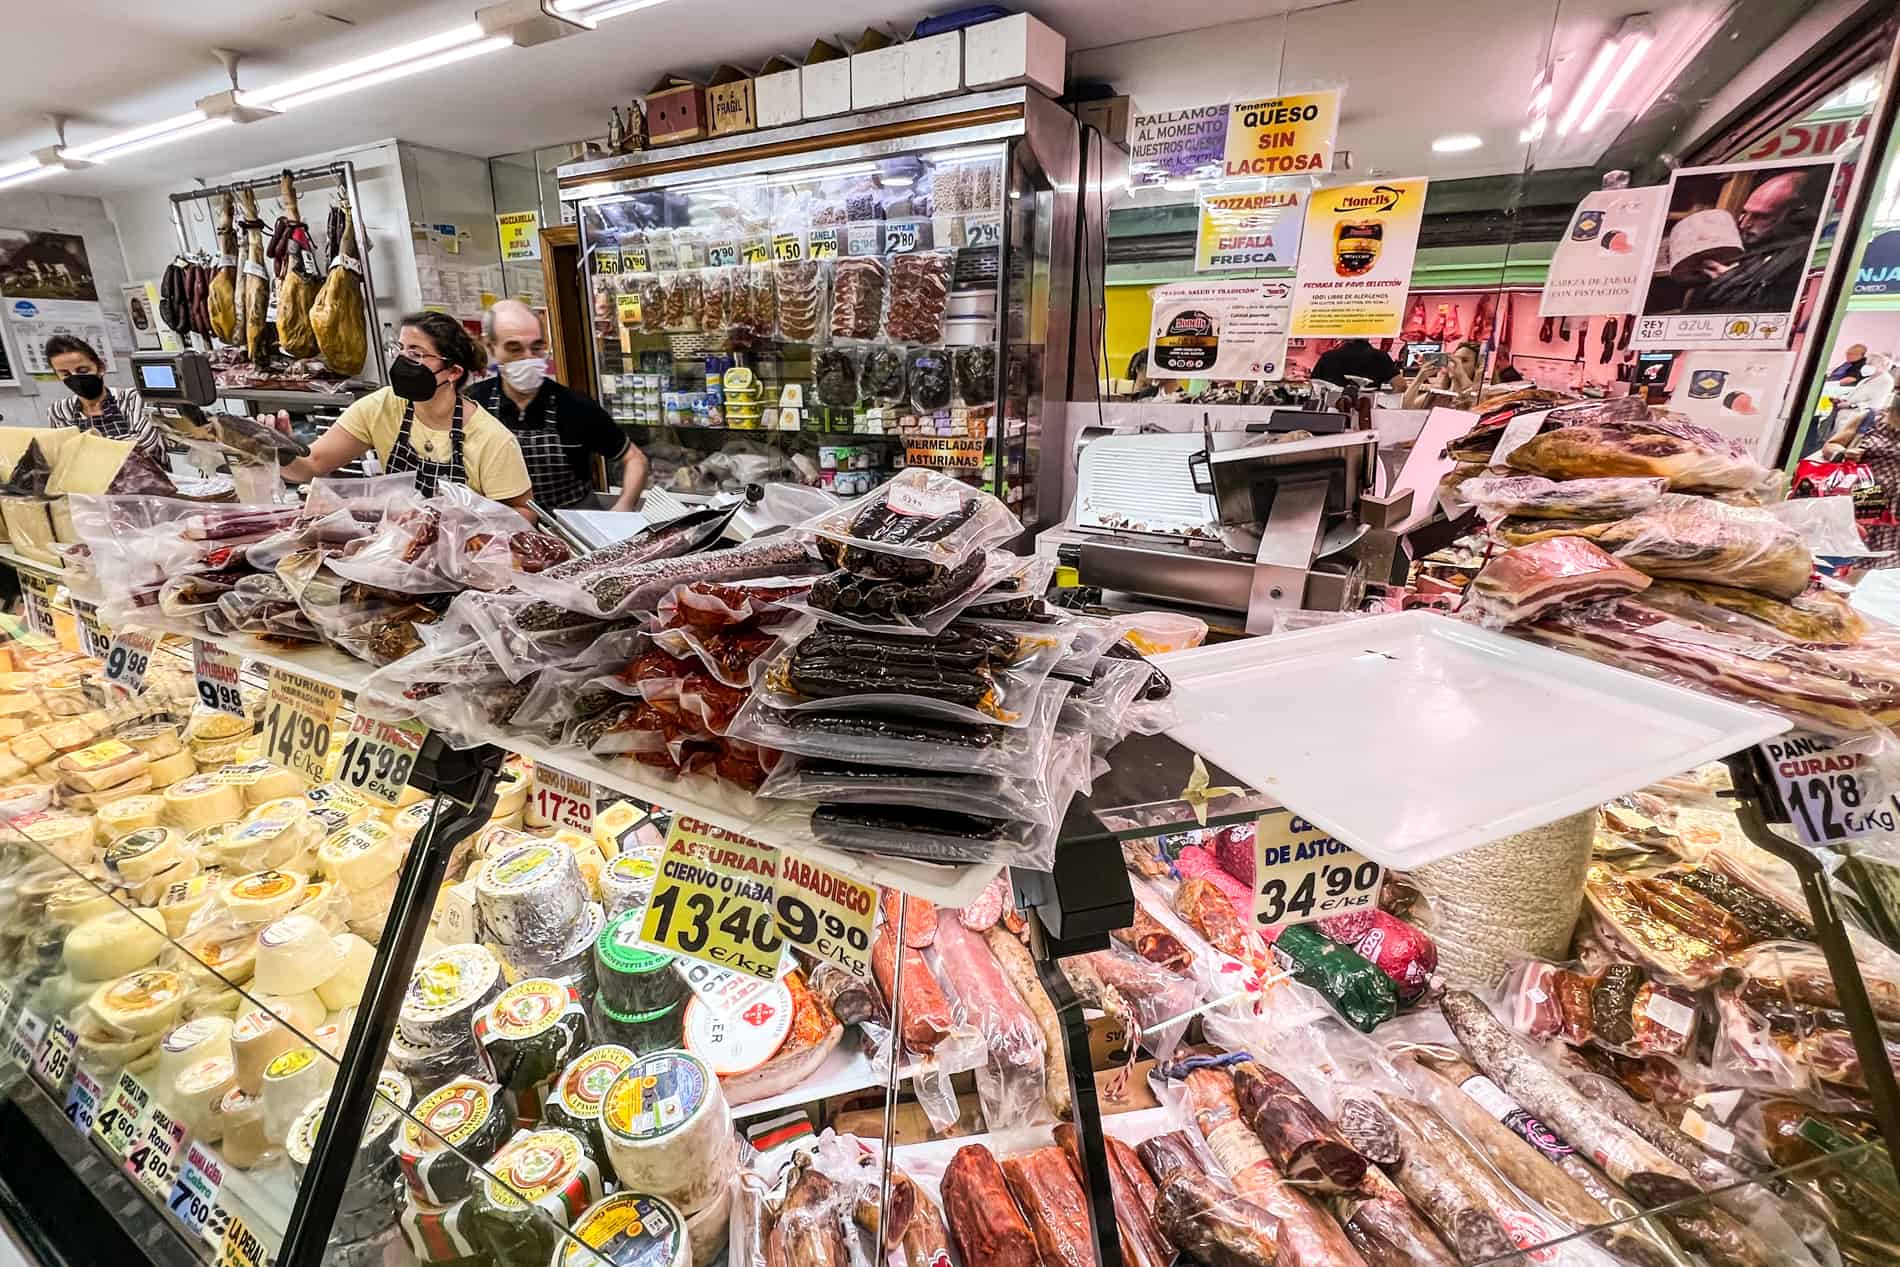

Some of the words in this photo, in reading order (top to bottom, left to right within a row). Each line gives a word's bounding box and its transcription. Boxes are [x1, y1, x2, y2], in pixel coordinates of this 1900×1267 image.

[1135, 104, 1229, 127] RALLAMOS
[1234, 100, 1283, 112] Tenemos
[1243, 105, 1318, 127] QUESO
[1138, 129, 1154, 141] AL
[1156, 120, 1223, 139] MOMENTO
[1258, 131, 1295, 149] SIN
[1132, 140, 1183, 157] NUESTROS
[1226, 153, 1323, 176] LACTOSA
[887, 233, 914, 254] 2'80
[1210, 252, 1277, 264] FRESCA
[907, 439, 982, 451] MERMELADAS
[909, 455, 978, 466] ASTURIANAS
[107, 647, 148, 678] 9'98
[198, 680, 242, 709] 9'98
[274, 669, 336, 700] ASTURIANO
[267, 703, 331, 766] 14'90
[352, 714, 375, 736] DE
[340, 737, 412, 787] 15'98
[537, 788, 591, 822] 17'20
[1265, 845, 1291, 866] DE
[664, 860, 717, 888] CIERVO
[720, 877, 733, 893] O
[782, 856, 871, 916] SABADIEGO
[1257, 861, 1379, 924] 34'90
[652, 885, 784, 953] 13'40
[776, 895, 869, 951] 9'90
[98, 1108, 134, 1137] 4'60
[130, 1147, 167, 1178] 4'80
[186, 1168, 212, 1199] Cabra
[171, 1179, 208, 1223] 7'60
[229, 1218, 242, 1244] LA
